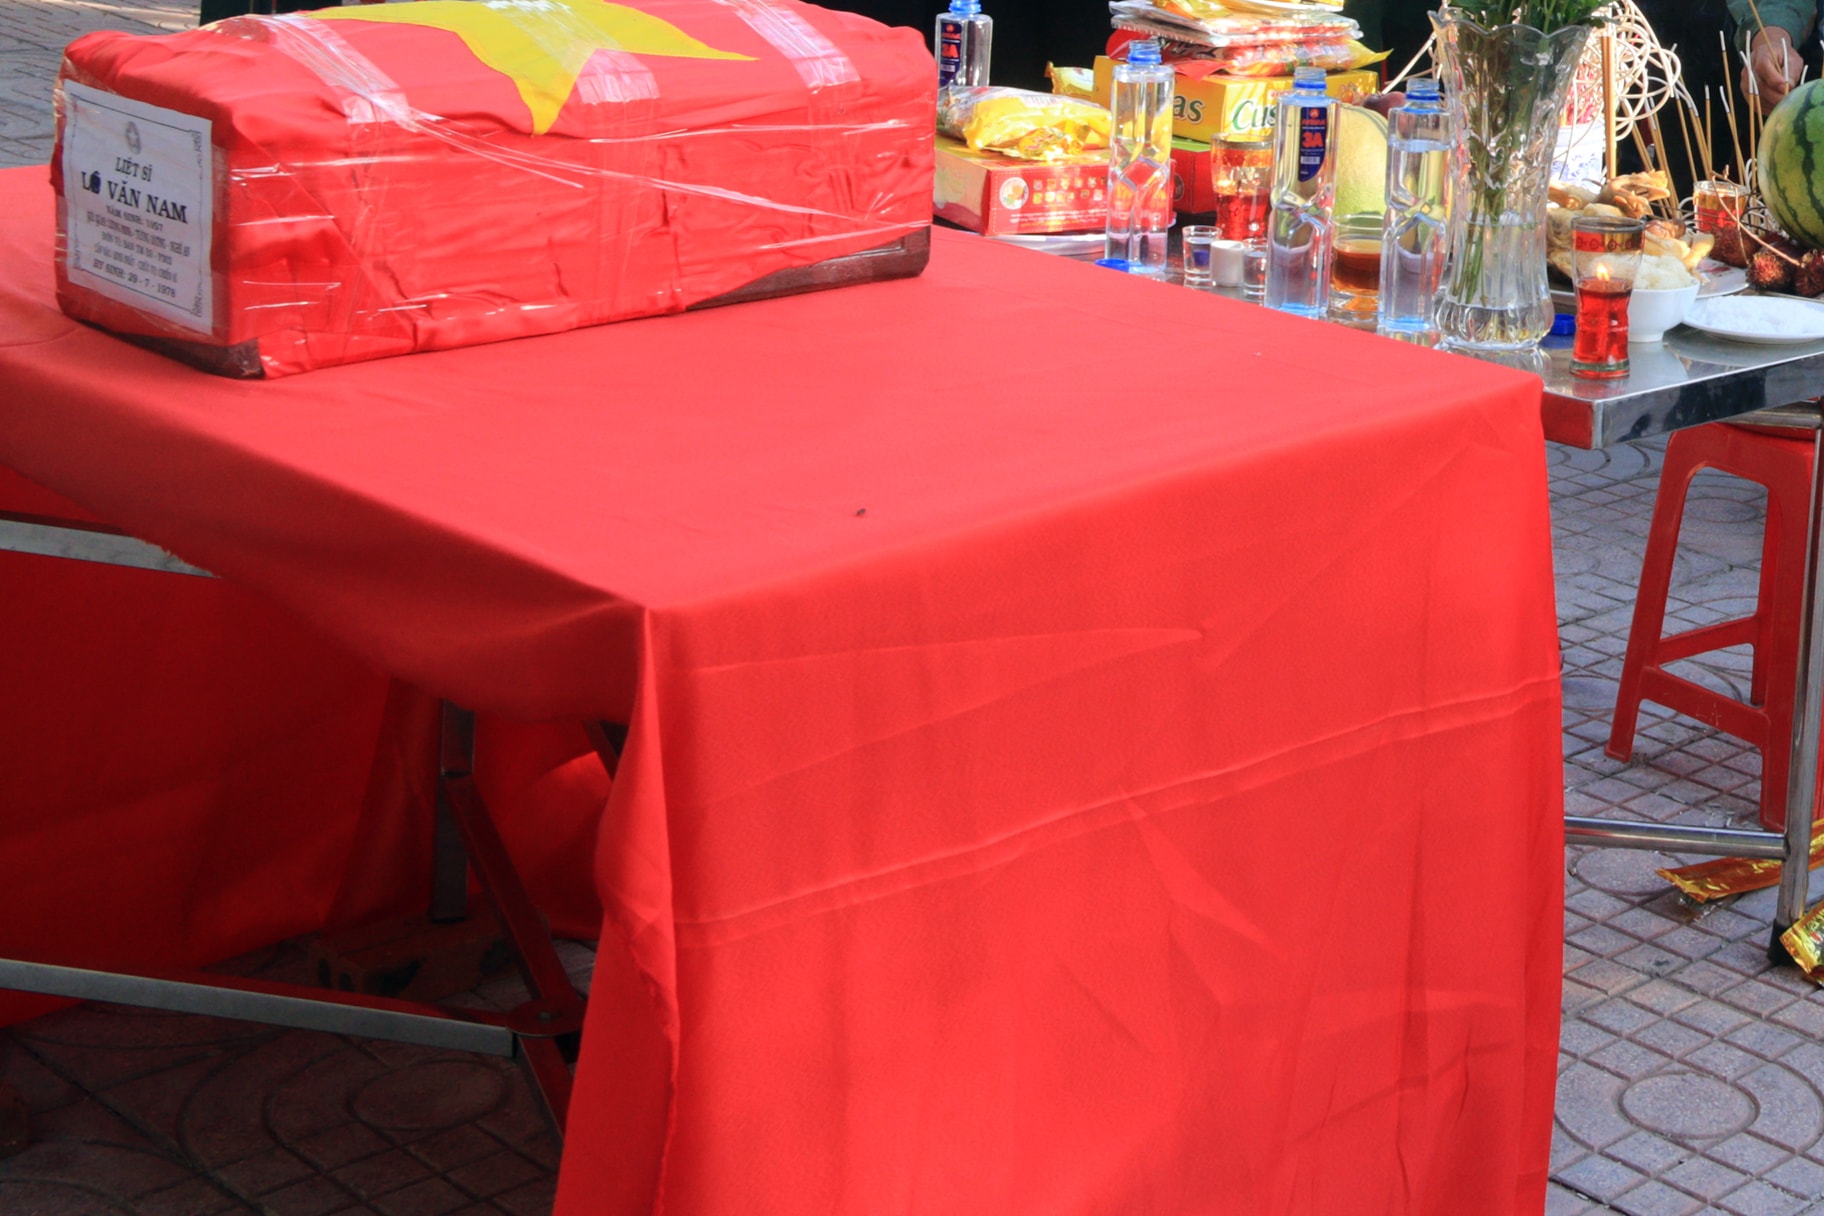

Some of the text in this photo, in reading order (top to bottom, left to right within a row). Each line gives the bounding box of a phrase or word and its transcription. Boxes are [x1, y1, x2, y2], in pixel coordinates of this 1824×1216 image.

[1302, 131, 1324, 148] 3A
[107, 179, 141, 208] VĂN
[146, 194, 188, 224] NAM
